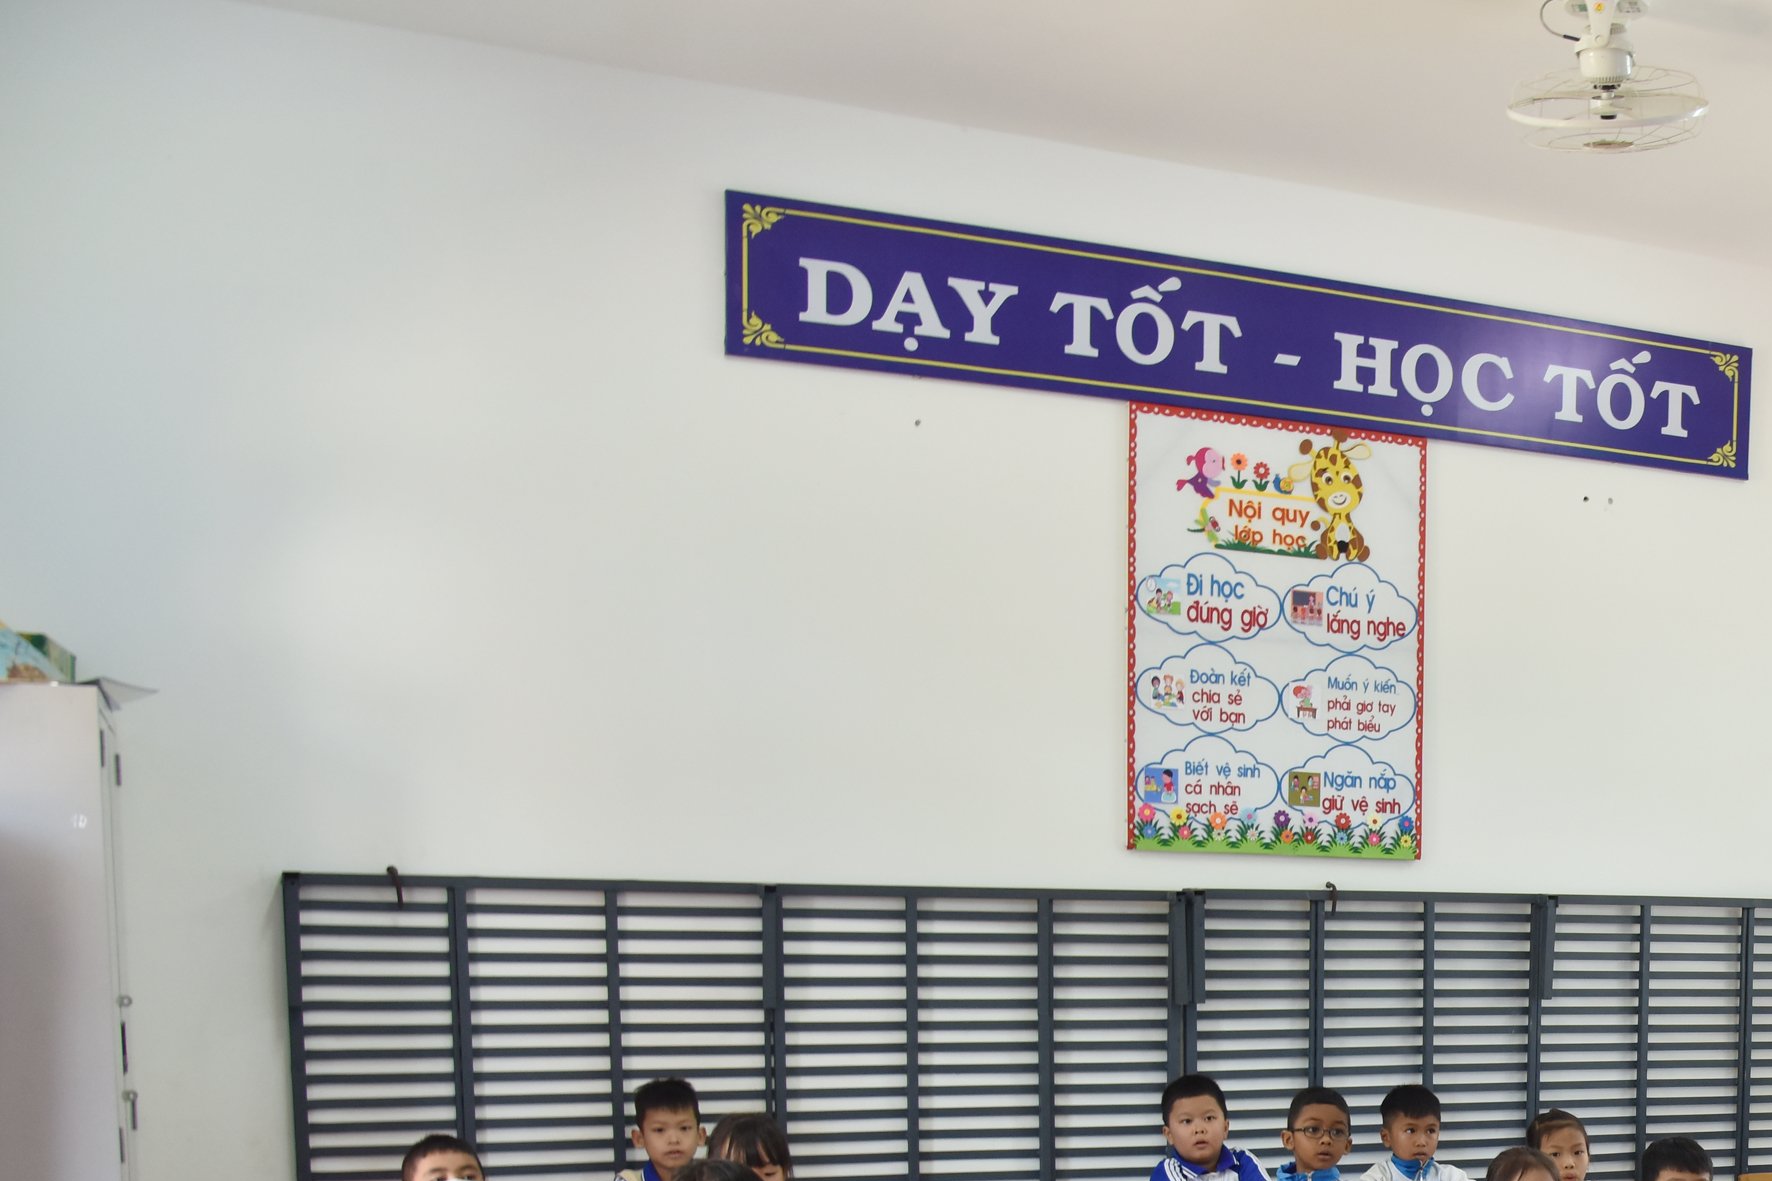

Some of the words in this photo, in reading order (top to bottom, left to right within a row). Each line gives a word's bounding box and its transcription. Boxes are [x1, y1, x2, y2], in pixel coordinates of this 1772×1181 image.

[799, 257, 1018, 351] DẠY
[1049, 276, 1242, 374] TỐT
[1333, 332, 1515, 417] HỌC
[1543, 351, 1700, 438] TỐT
[1228, 499, 1262, 523] Nội
[1272, 506, 1310, 527] quy
[1234, 525, 1263, 547] lớp
[1272, 529, 1307, 550] học
[1187, 573, 1203, 596] Đi
[1210, 574, 1244, 603] học
[1326, 586, 1358, 608] Chú
[1366, 589, 1375, 614] ý
[1187, 600, 1232, 631] đúng
[1241, 605, 1268, 632] giờ
[1327, 610, 1360, 641] lắng
[1367, 617, 1406, 642] nghe
[1190, 668, 1225, 685] Đoàn
[1230, 668, 1251, 687] kết
[1328, 674, 1358, 691] Muốn
[1363, 678, 1370, 694] ý
[1374, 678, 1396, 695] kiến
[1192, 688, 1220, 704] chia
[1228, 689, 1242, 705] sẻ
[1327, 695, 1351, 712] phải
[1356, 700, 1374, 715] giơ
[1378, 700, 1396, 716] tay
[1192, 705, 1213, 722] với
[1220, 708, 1246, 727] bạn
[1327, 716, 1352, 732] phát
[1358, 715, 1381, 733] biểu
[1185, 758, 1208, 776] Biết
[1216, 762, 1231, 779] vệ
[1237, 763, 1260, 778] sinh
[1185, 779, 1202, 795] cá
[1209, 781, 1241, 796] nhân
[1324, 770, 1362, 791] Ngăn
[1369, 769, 1396, 793] nắp
[1186, 800, 1217, 817] sạch
[1322, 795, 1344, 815] giữ
[1351, 796, 1368, 816] vệ
[1375, 798, 1401, 814] sinh
